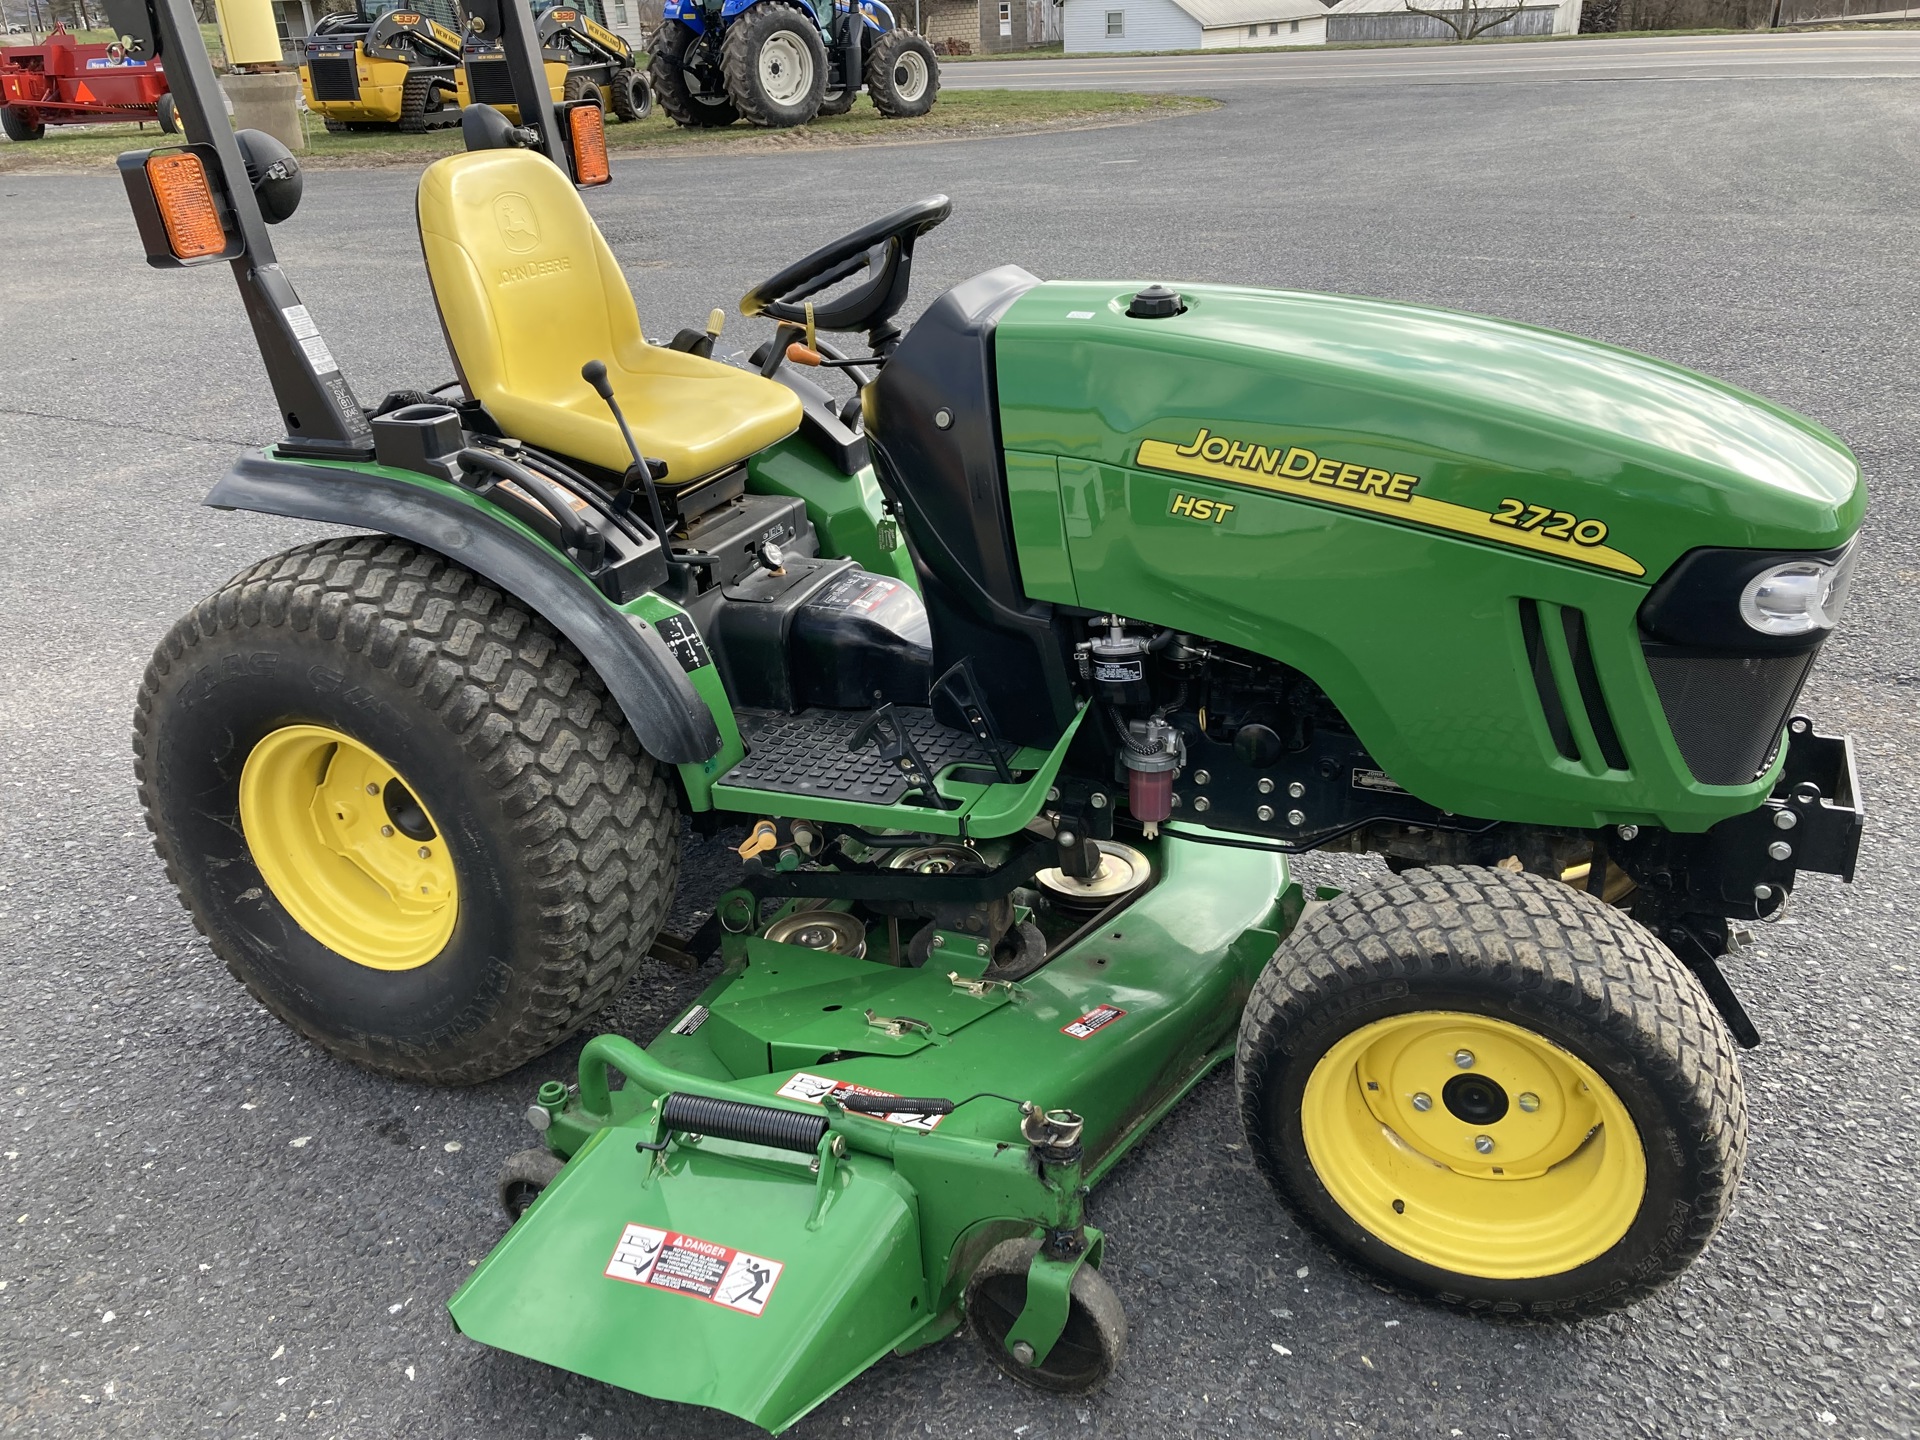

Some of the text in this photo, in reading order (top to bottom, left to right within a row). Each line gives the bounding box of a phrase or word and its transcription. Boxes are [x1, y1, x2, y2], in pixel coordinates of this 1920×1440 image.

[434, 26, 447, 41] NEW
[588, 23, 619, 49] NEW HOLLAND
[498, 256, 572, 287] JOHN DEERE
[1176, 428, 1420, 502] JOHN DEERE
[1170, 494, 1234, 524] HST
[1489, 497, 1609, 547] 2720
[683, 1237, 727, 1258] DANGER
